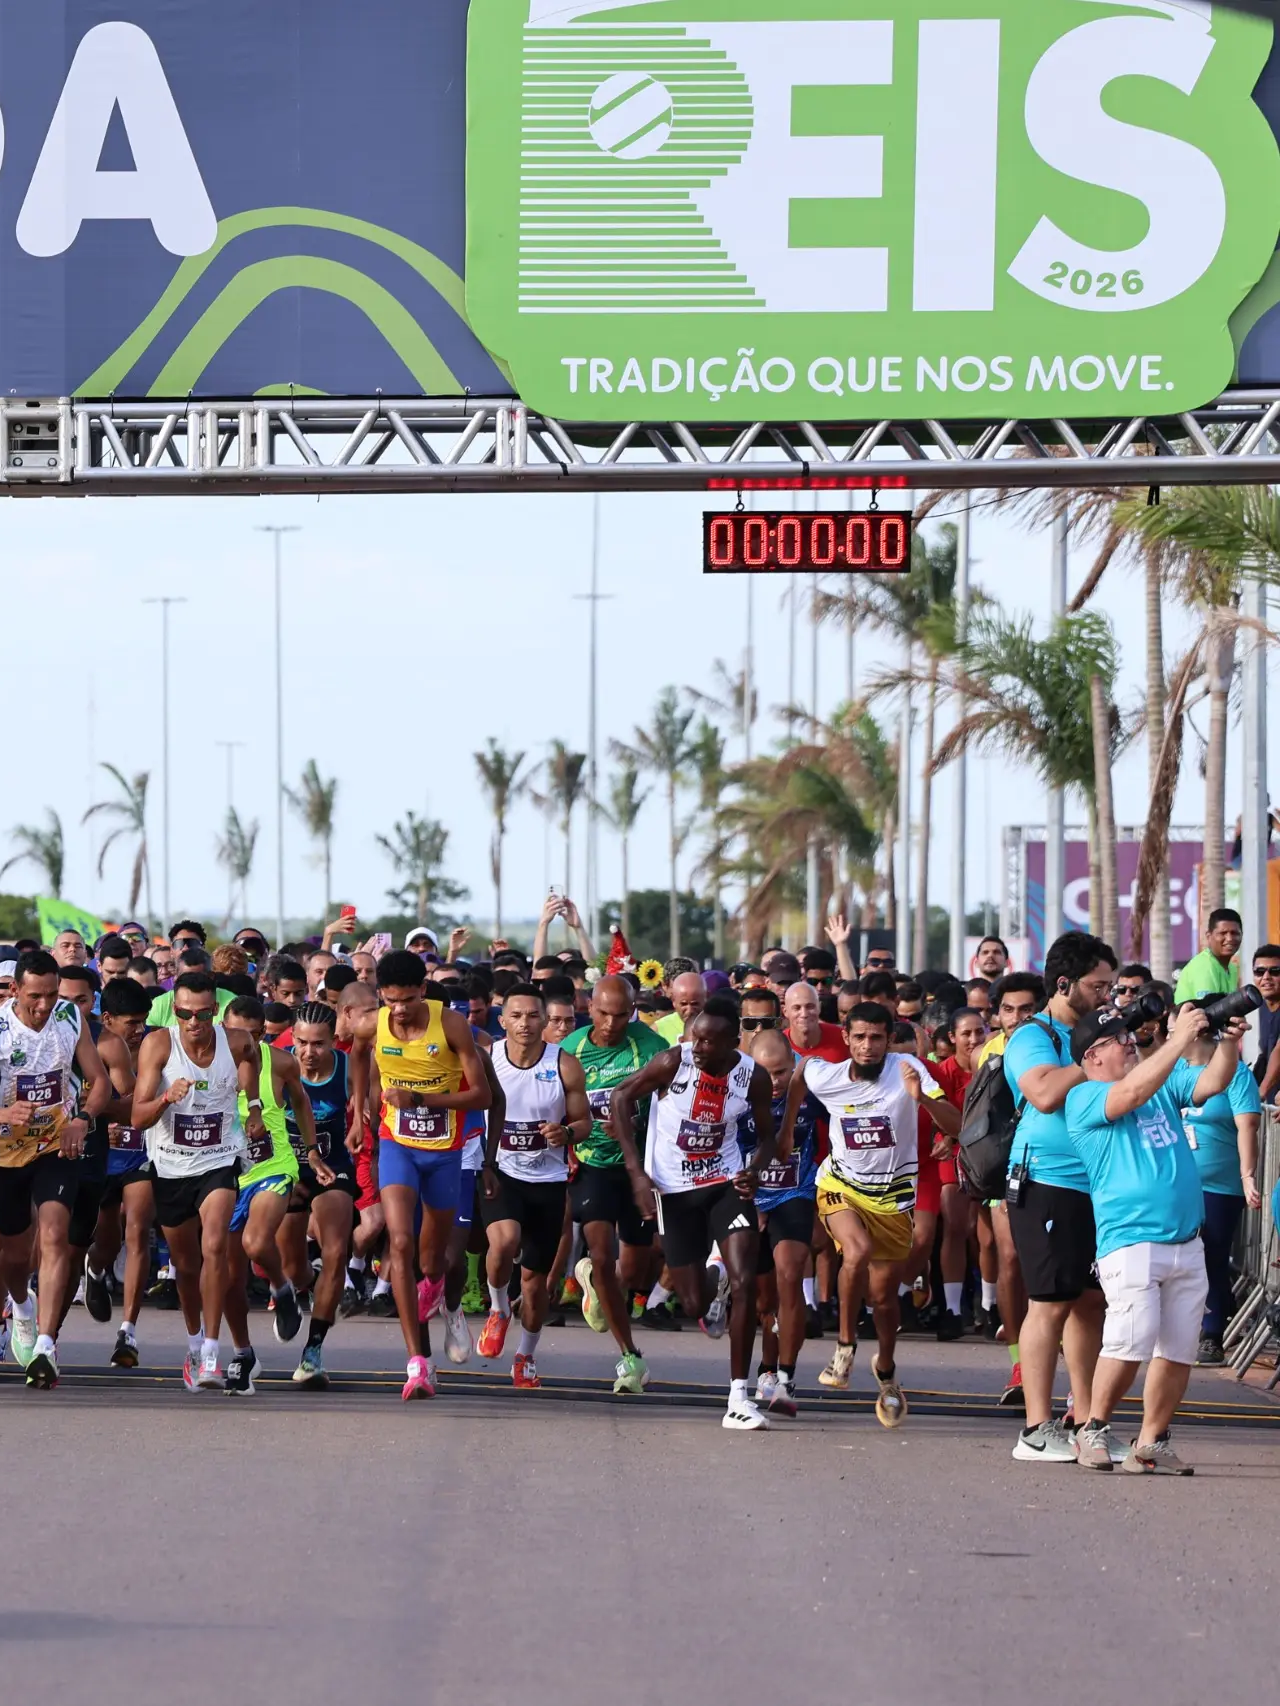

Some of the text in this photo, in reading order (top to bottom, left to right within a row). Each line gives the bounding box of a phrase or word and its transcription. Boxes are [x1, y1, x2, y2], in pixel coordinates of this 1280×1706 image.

[518, 15, 1226, 314] REIS
[1043, 261, 1144, 297] 2026
[561, 347, 1174, 402] TRADIÇÃO QUE NOS MOVE.
[27, 1088, 52, 1101] 028
[409, 1119, 436, 1132] 038
[184, 1129, 210, 1141] 008
[509, 1135, 535, 1146] 037
[853, 1132, 881, 1144] 004
[687, 1137, 714, 1147] 045
[761, 1170, 786, 1182] 017
